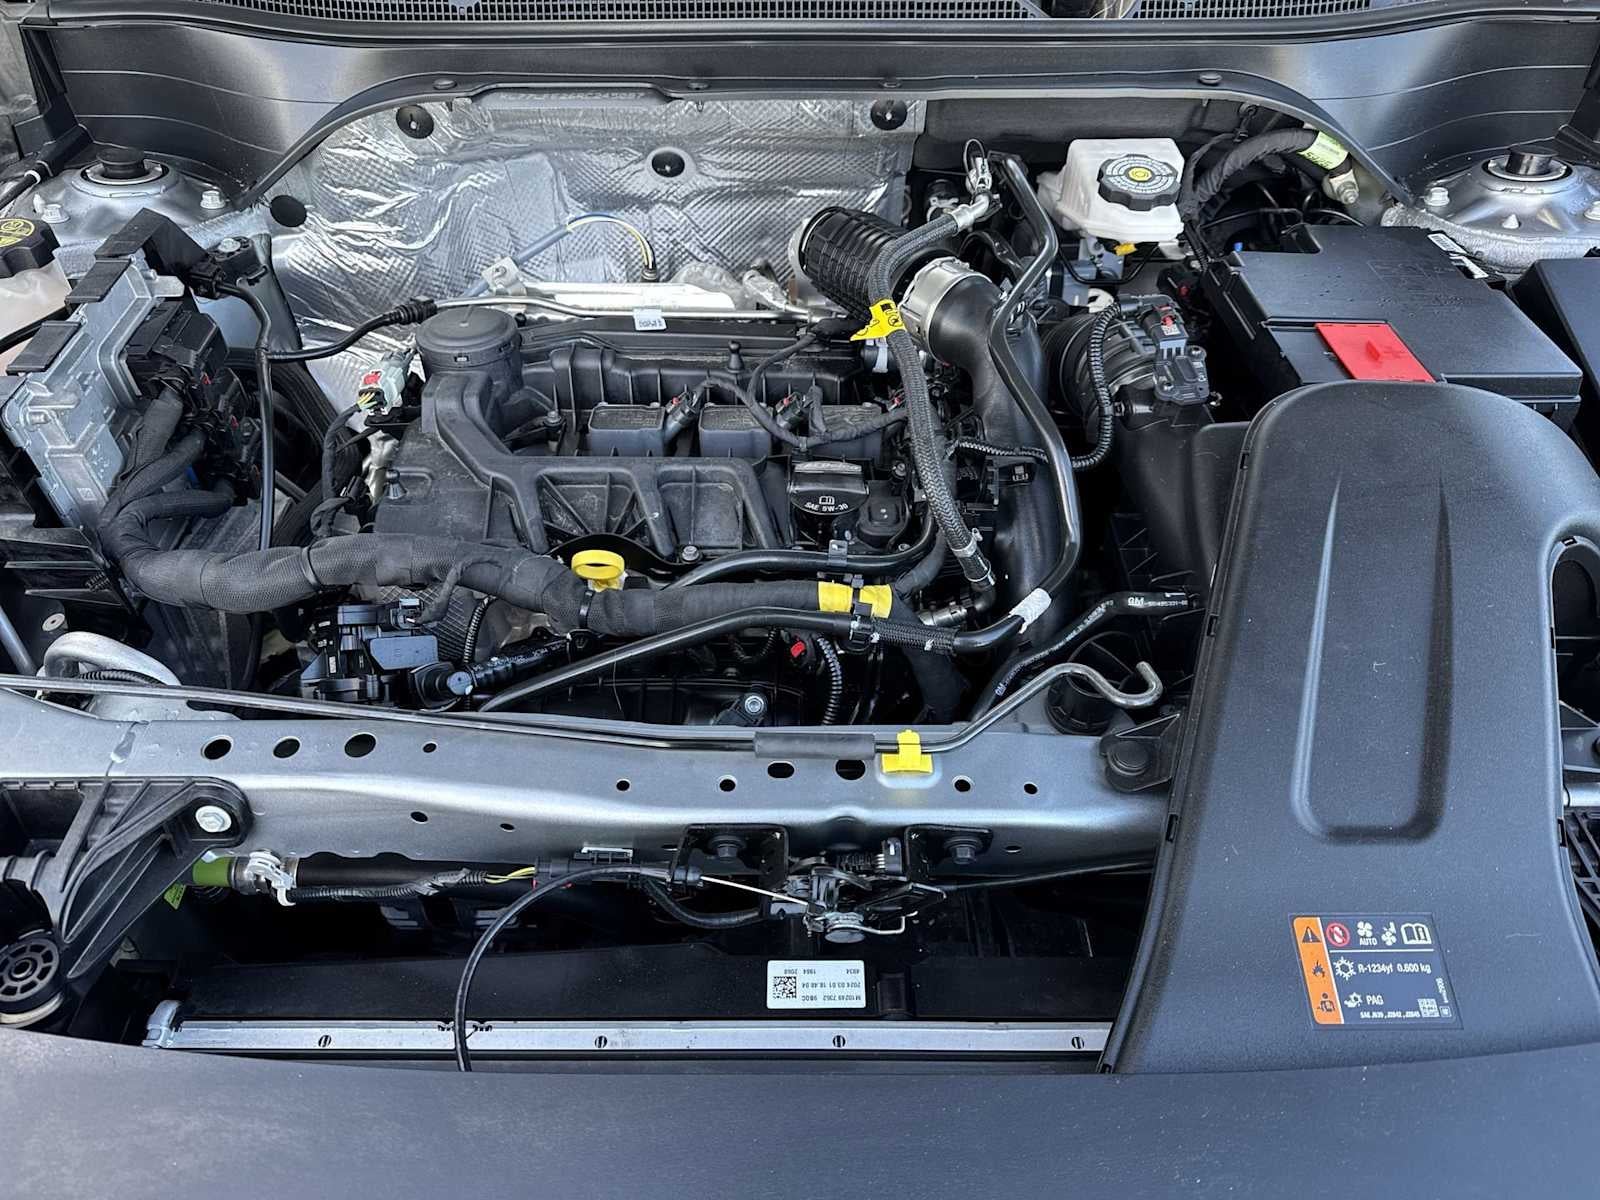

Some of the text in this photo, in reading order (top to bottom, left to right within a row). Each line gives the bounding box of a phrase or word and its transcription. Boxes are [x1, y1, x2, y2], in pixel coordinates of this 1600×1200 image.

[804, 502, 848, 512] SAE 5W-30
[1359, 937, 1378, 946] AUTO
[1420, 962, 1431, 974] kg
[1366, 995, 1384, 1005] PAG
